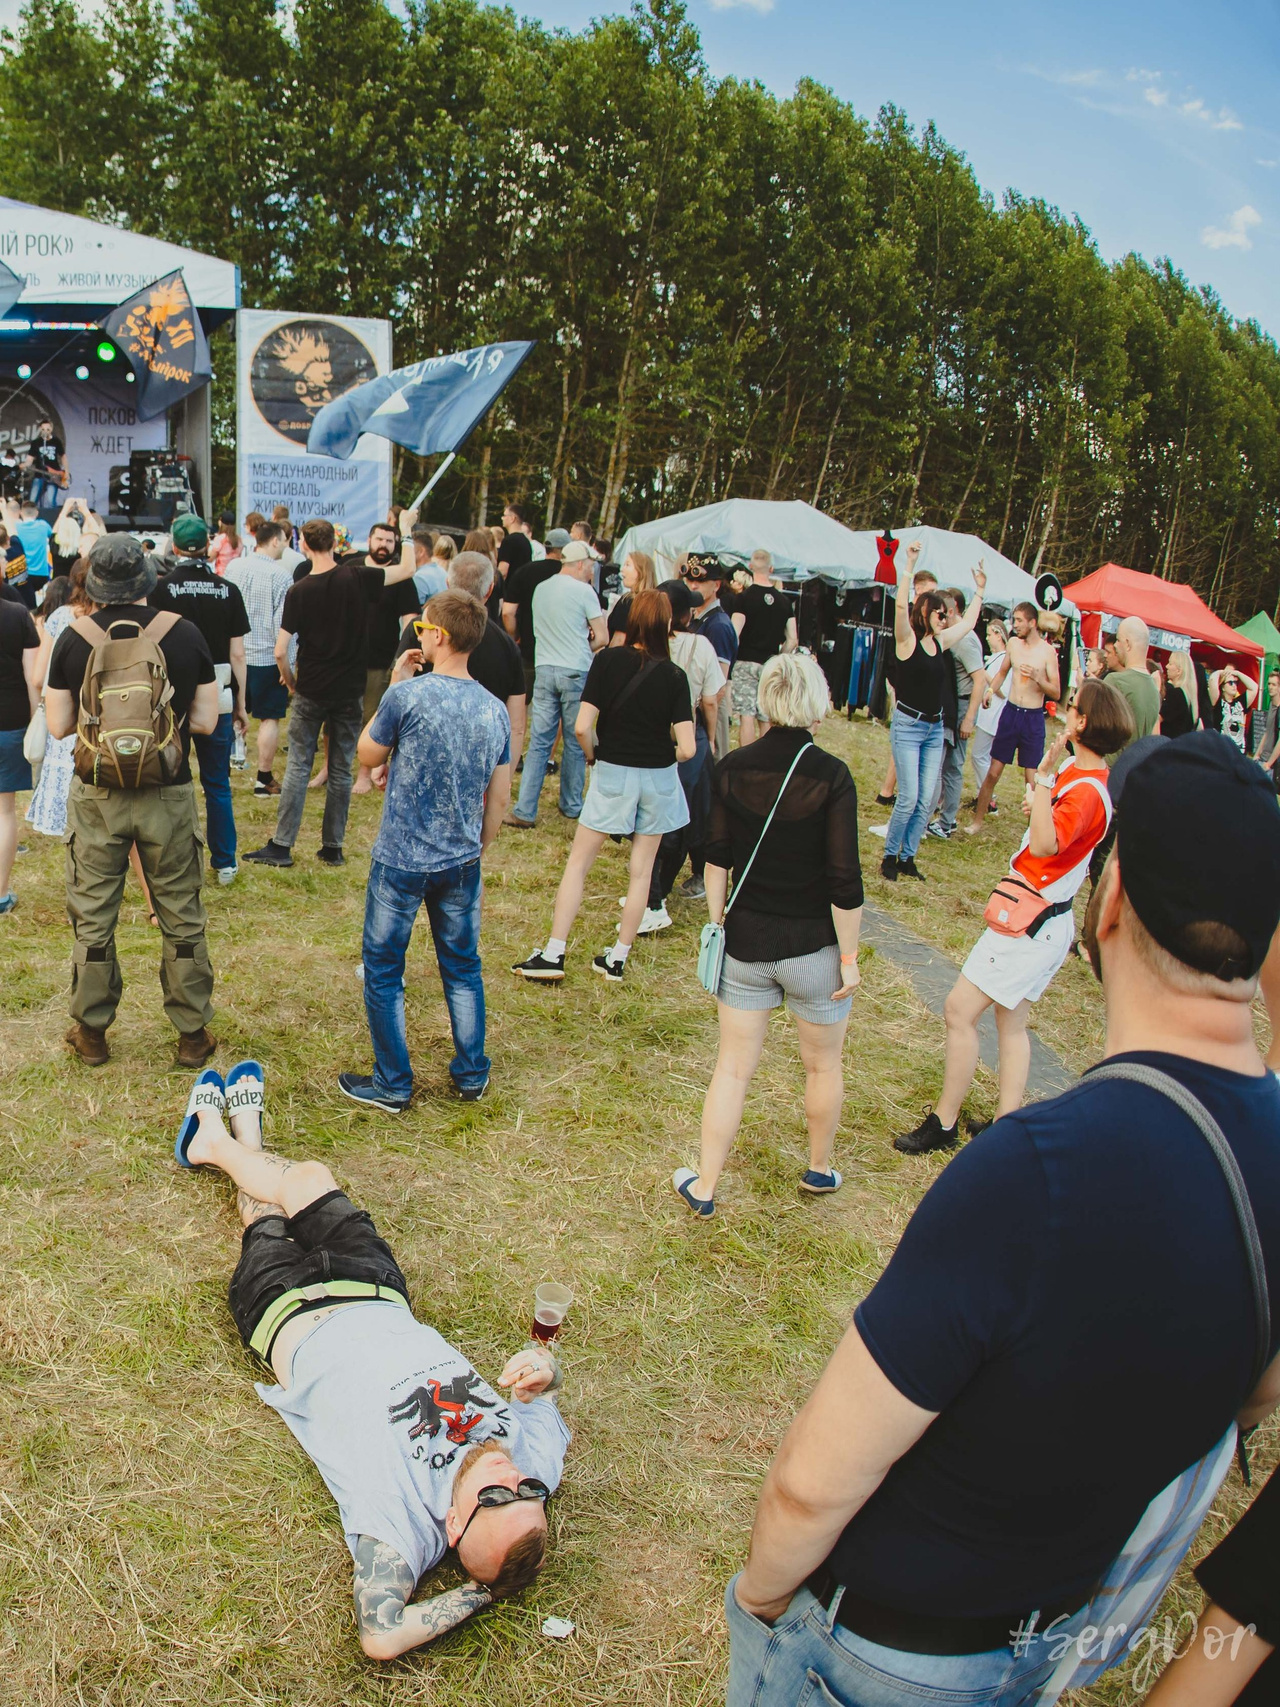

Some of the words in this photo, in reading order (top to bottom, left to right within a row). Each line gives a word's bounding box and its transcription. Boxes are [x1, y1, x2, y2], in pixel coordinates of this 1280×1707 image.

[25, 233, 74, 257] РОК»
[57, 270, 103, 287] ЖИВОЙ
[88, 406, 136, 426] ПСКОВ
[90, 435, 134, 455] ЖДЕТ
[252, 462, 359, 482] МЕЖДУНАРОДНЫЙ
[252, 481, 321, 498] ФЕСТИВАЛЬ
[297, 500, 346, 517] МУЗЫКИ
[1161, 632, 1191, 651] КОФЕ
